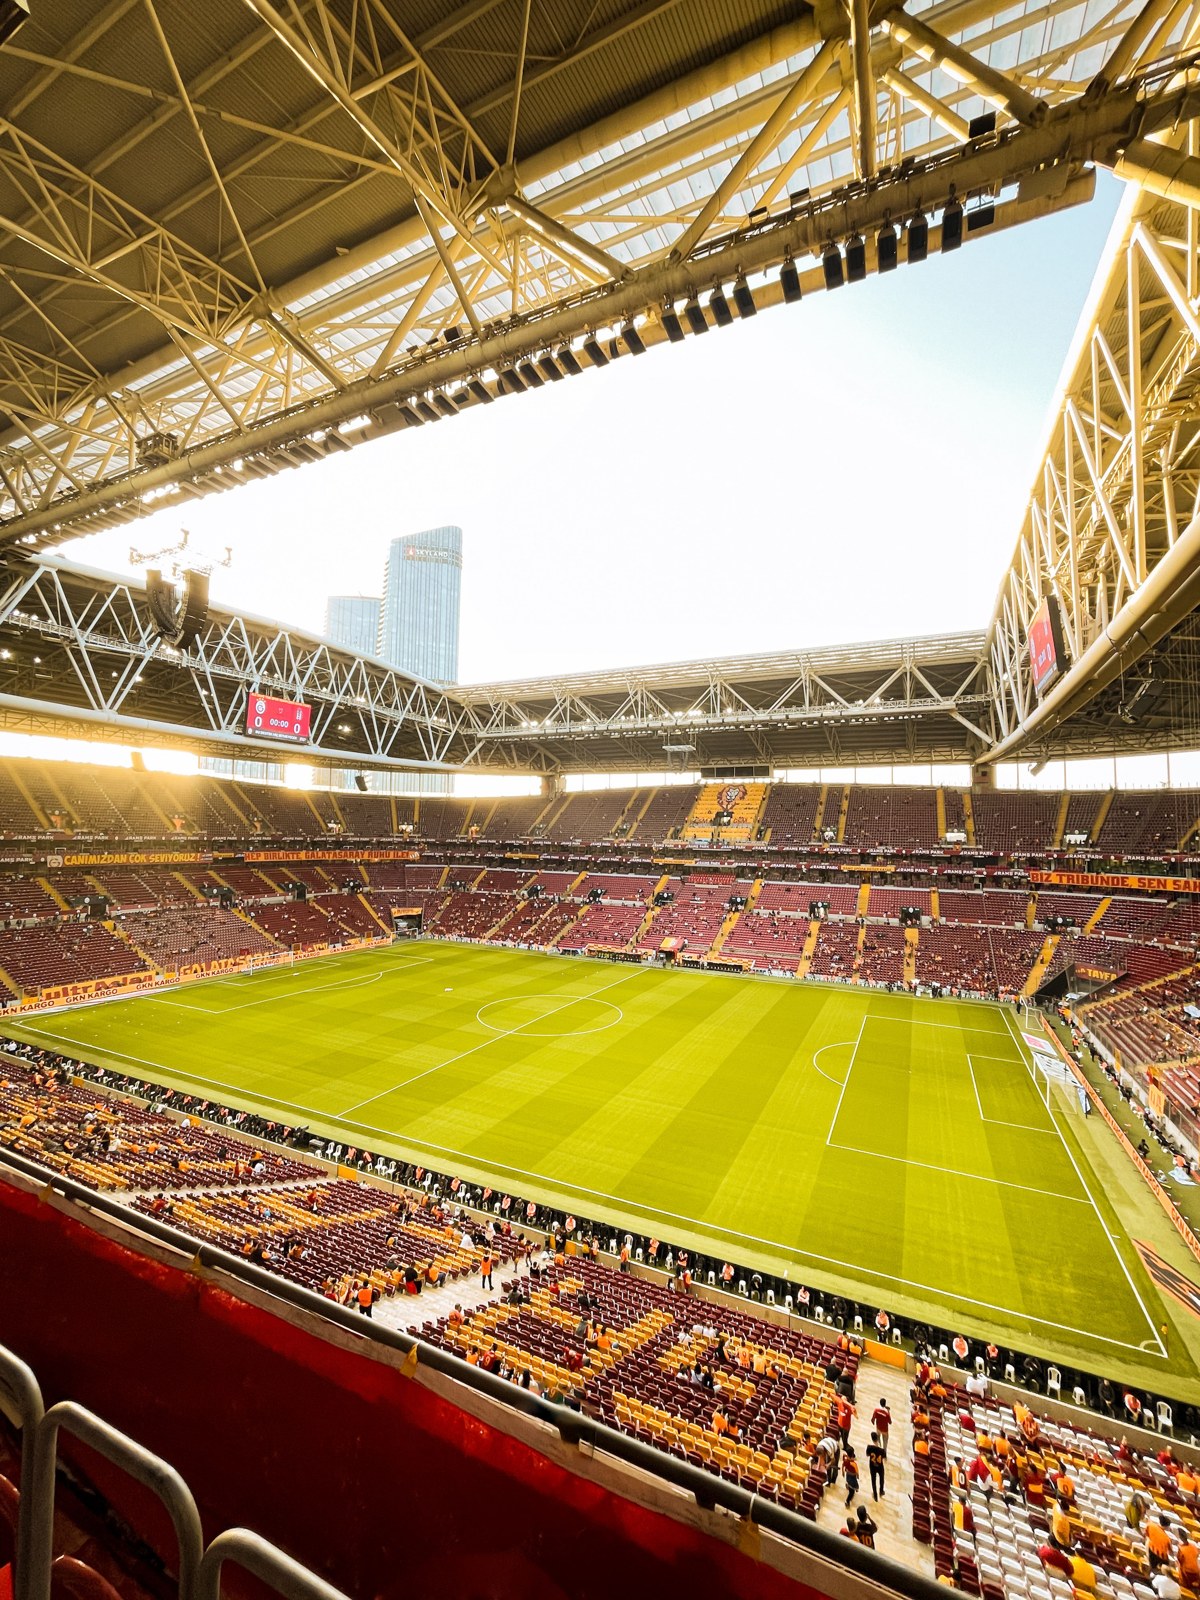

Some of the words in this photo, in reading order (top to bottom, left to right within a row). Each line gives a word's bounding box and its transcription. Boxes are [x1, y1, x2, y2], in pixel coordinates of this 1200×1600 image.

[416, 550, 448, 558] SKYLAND
[254, 716, 262, 727] 0
[269, 718, 288, 728] 00:00
[294, 724, 300, 734] 0
[1138, 878, 1167, 889] SEN
[212, 968, 233, 976] KARGO
[1087, 969, 1118, 980] TAYFA
[136, 981, 153, 990] GKN
[155, 977, 180, 987] KARGO
[66, 994, 85, 1003] GKN
[88, 989, 117, 999] KARGO
[20, 1001, 54, 1012] KARGO
[871, 1452, 882, 1464] 24
[862, 1535, 872, 1546] 10
